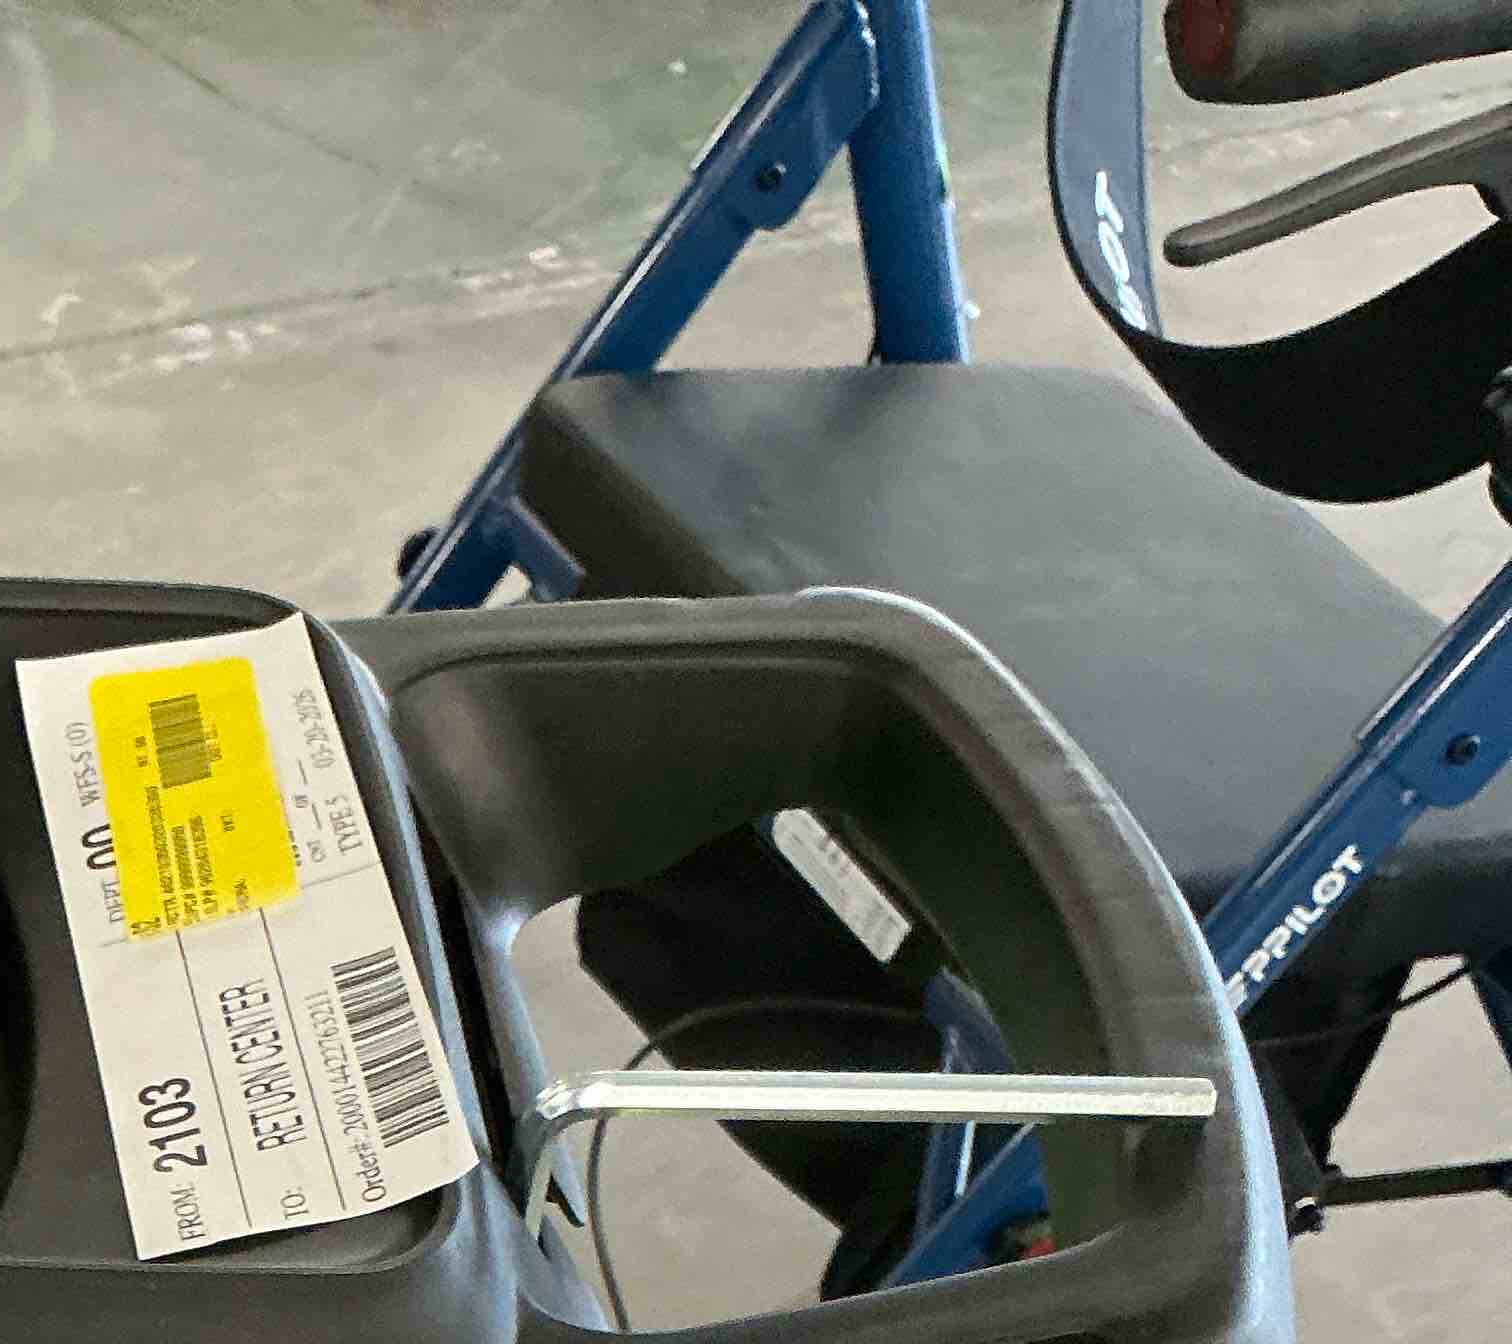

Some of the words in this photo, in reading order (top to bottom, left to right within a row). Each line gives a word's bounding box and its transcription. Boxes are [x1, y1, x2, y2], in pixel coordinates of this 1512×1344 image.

[329, 811, 364, 857] TYPE
[218, 978, 284, 1064] CENTER
[138, 1077, 208, 1173] 2103
[240, 1062, 308, 1151] RETURN
[170, 1182, 207, 1241] FROM:
[281, 1186, 310, 1220] TO:
